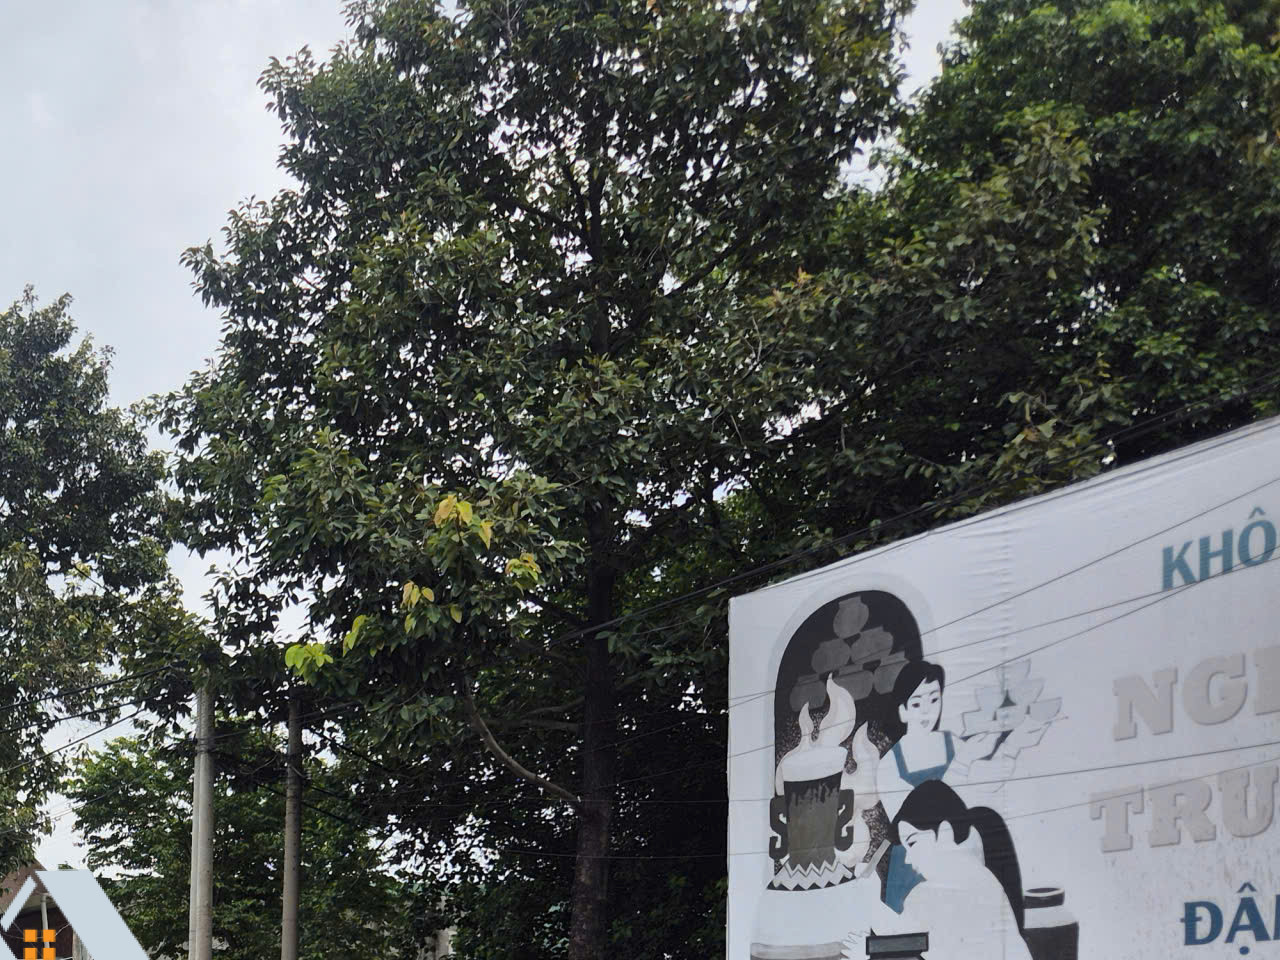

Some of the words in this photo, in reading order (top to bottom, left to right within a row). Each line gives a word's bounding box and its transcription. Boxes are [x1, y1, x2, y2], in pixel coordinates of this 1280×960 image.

[1162, 506, 1280, 592] KHÔ
[1089, 765, 1279, 854] TRU
[1180, 881, 1280, 956] ĐẬ
